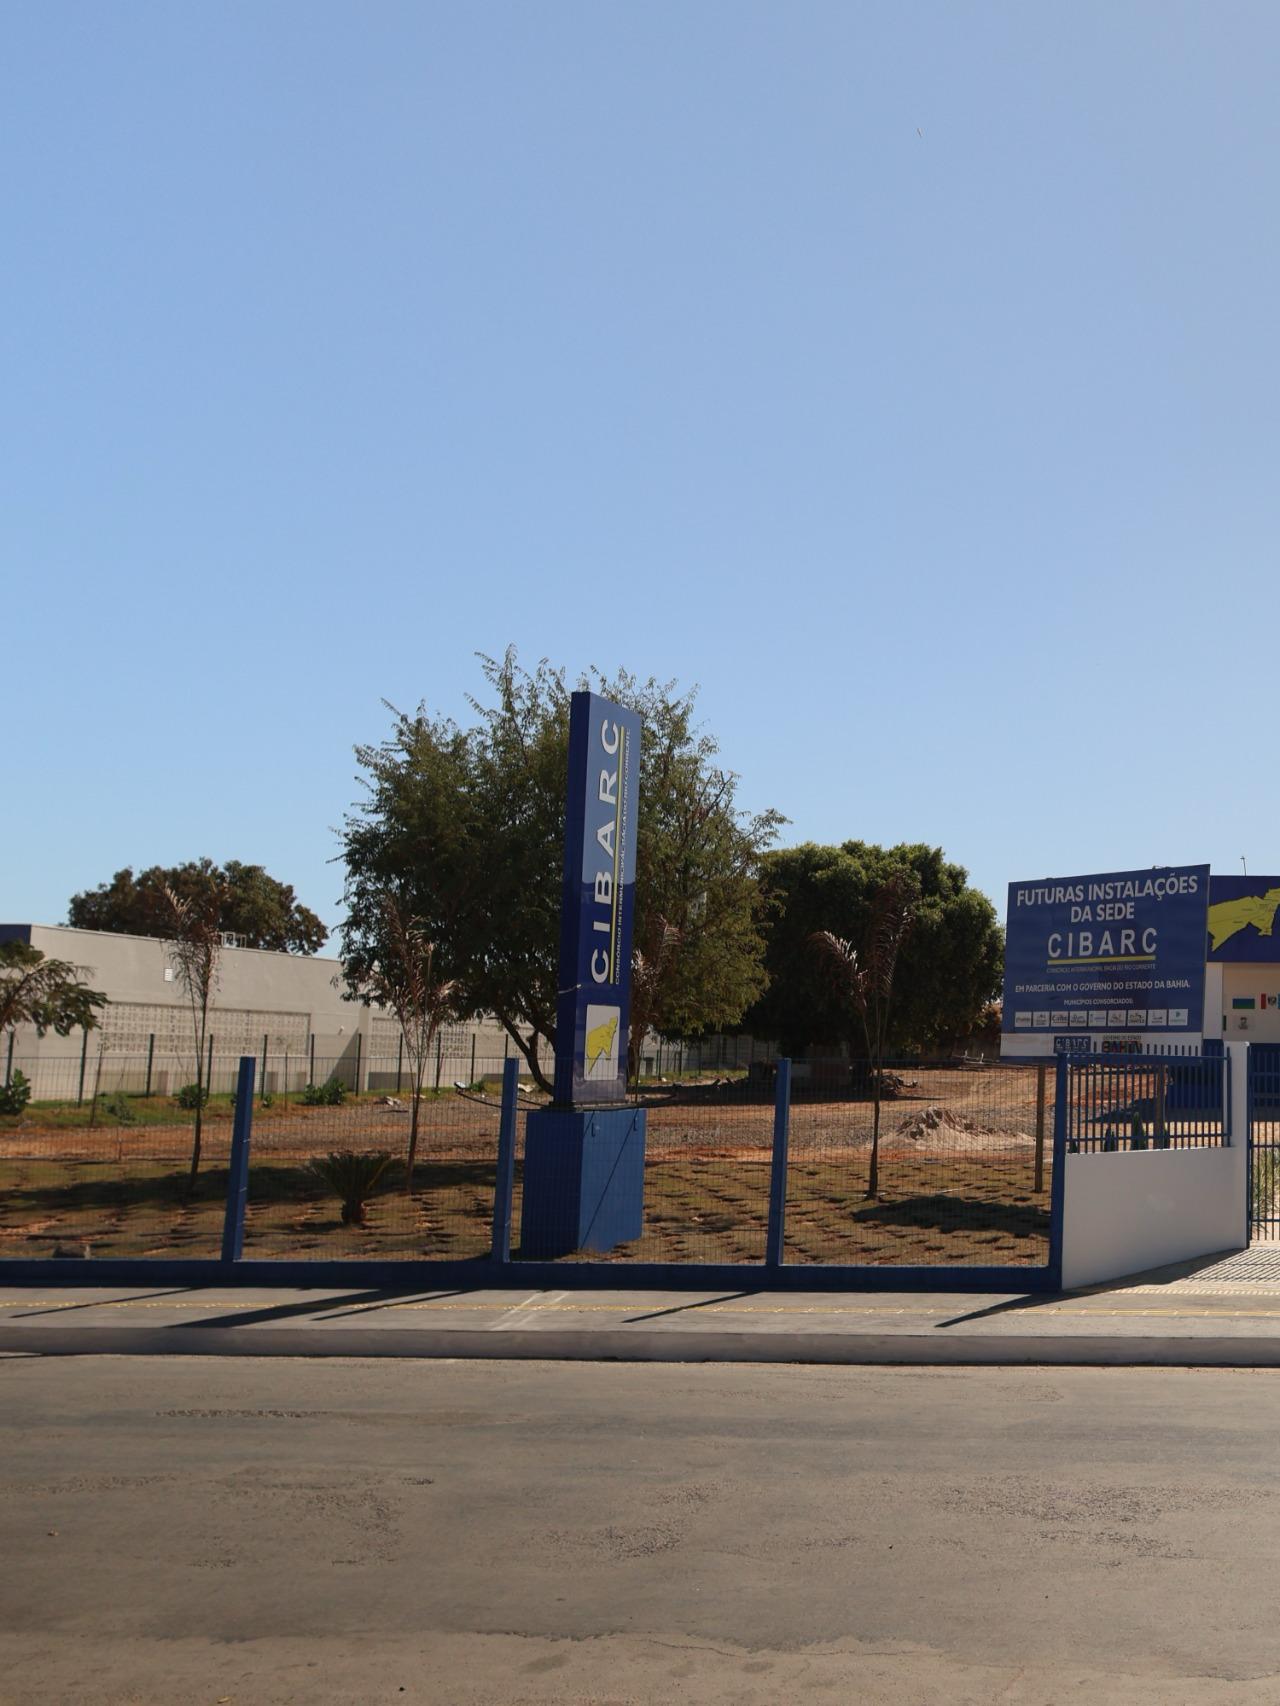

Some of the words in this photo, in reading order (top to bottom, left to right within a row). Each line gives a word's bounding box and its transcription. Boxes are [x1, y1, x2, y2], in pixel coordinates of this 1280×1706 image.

[591, 719, 619, 984] CIBARC
[1016, 884, 1084, 907] FUTURAS
[1088, 873, 1198, 901] INSTALAÇÕES
[1071, 905, 1093, 923] DA
[1096, 902, 1135, 921] SEDE
[1047, 927, 1158, 958] CIBARC
[1015, 985, 1025, 993] EM
[1025, 983, 1056, 993] PARCERIA
[1056, 983, 1072, 992] COM
[1072, 983, 1078, 991] O
[1079, 982, 1112, 991] GOVERNO
[1113, 982, 1124, 990] DO
[1125, 981, 1153, 990] ESTADO
[1154, 980, 1165, 989] DA
[1166, 979, 1191, 989] BAHIA.
